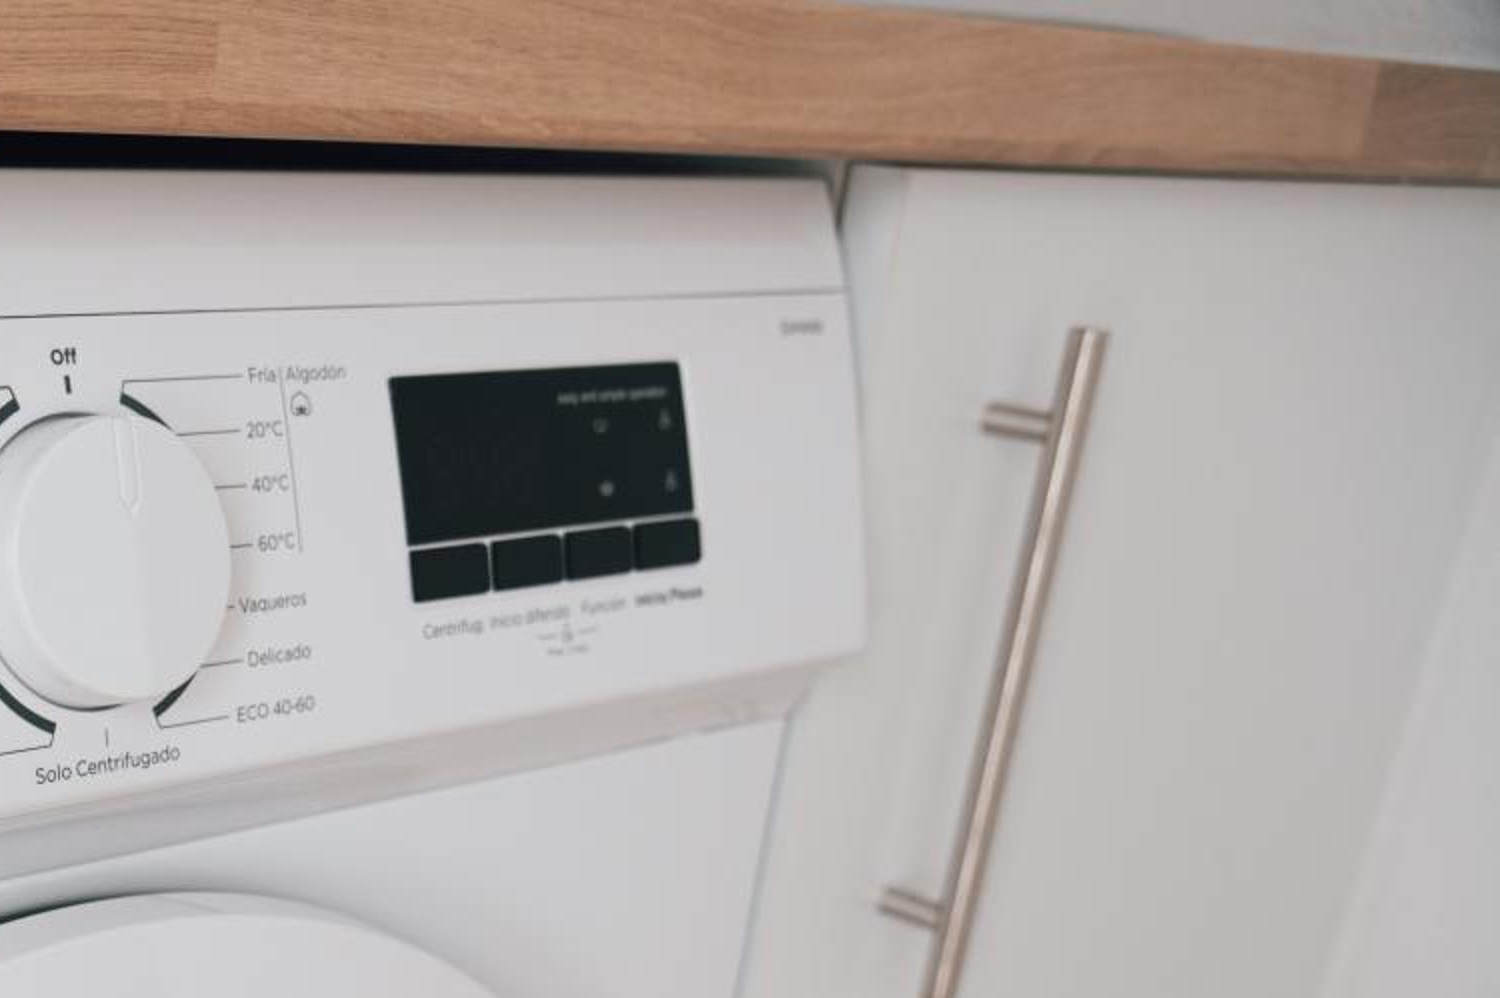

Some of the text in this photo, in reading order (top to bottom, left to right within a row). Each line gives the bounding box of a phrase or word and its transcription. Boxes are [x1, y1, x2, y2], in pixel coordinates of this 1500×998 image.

[50, 347, 77, 365] Off
[246, 420, 283, 440] 20°C
[252, 473, 289, 493] 40°C
[257, 531, 296, 553] 60°C
[238, 592, 307, 614] Vaqueros
[247, 642, 311, 669] Delicado
[236, 696, 316, 724] ECO 40-60
[35, 744, 181, 785] Solo Centrifugado
